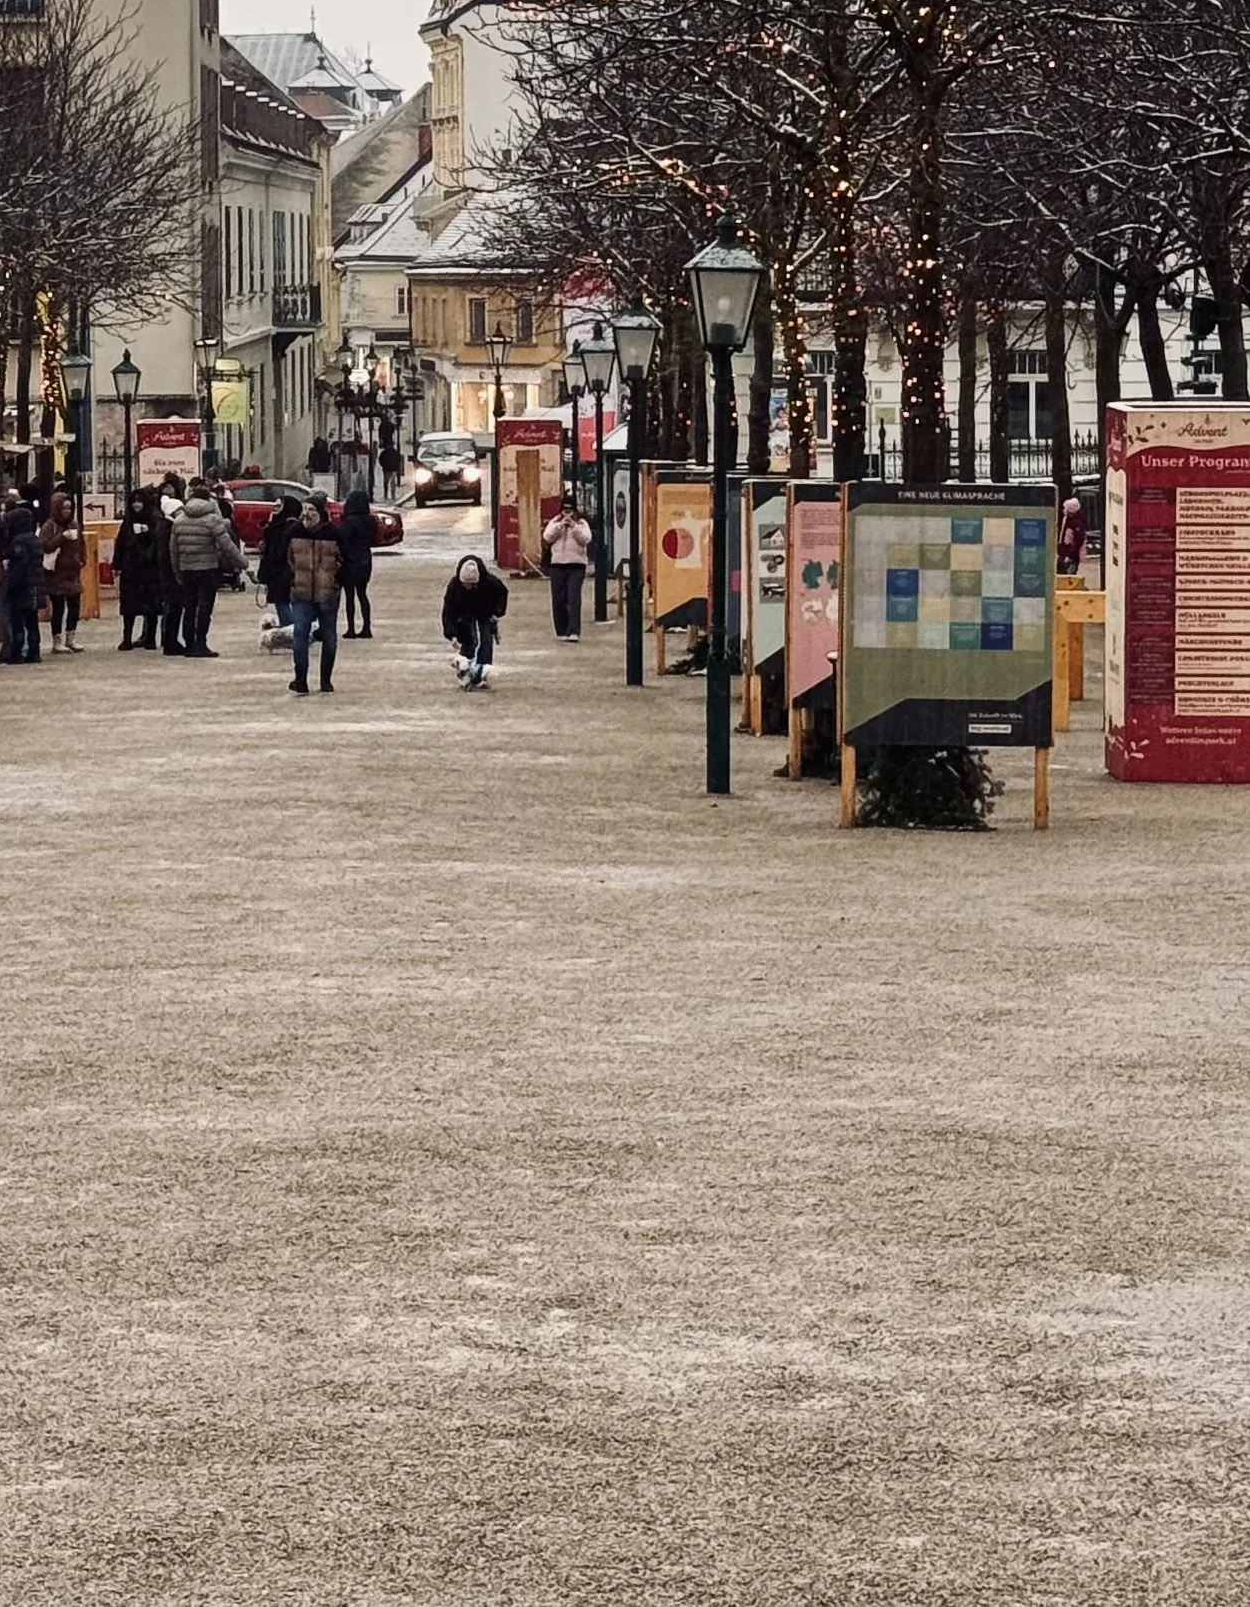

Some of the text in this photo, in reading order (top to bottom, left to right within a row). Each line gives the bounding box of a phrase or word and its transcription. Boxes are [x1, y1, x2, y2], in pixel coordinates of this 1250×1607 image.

[1178, 422, 1229, 438] Advent
[1140, 454, 1185, 468] Unser
[897, 491, 1005, 501] EINE NEUE KLIMASPRACHE
